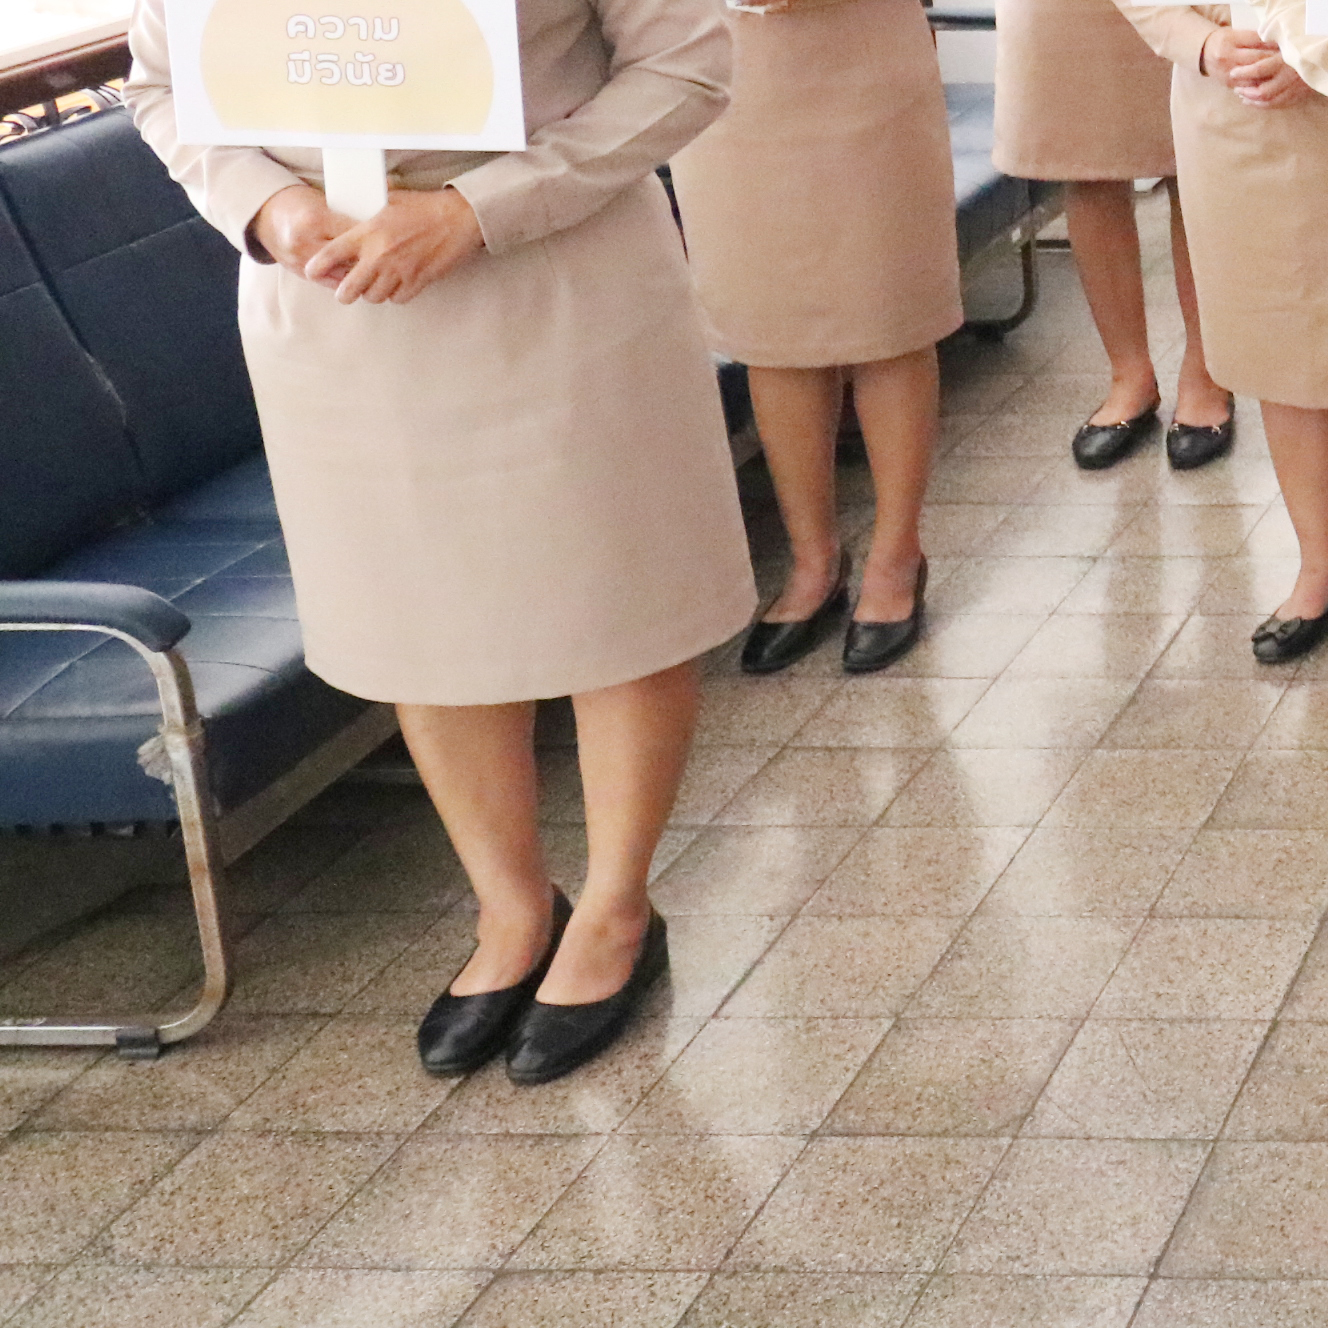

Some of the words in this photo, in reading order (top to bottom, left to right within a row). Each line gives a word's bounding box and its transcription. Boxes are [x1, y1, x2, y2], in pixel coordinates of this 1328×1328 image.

[285, 13, 401, 41] ความ
[285, 49, 407, 87] มีวินัย
